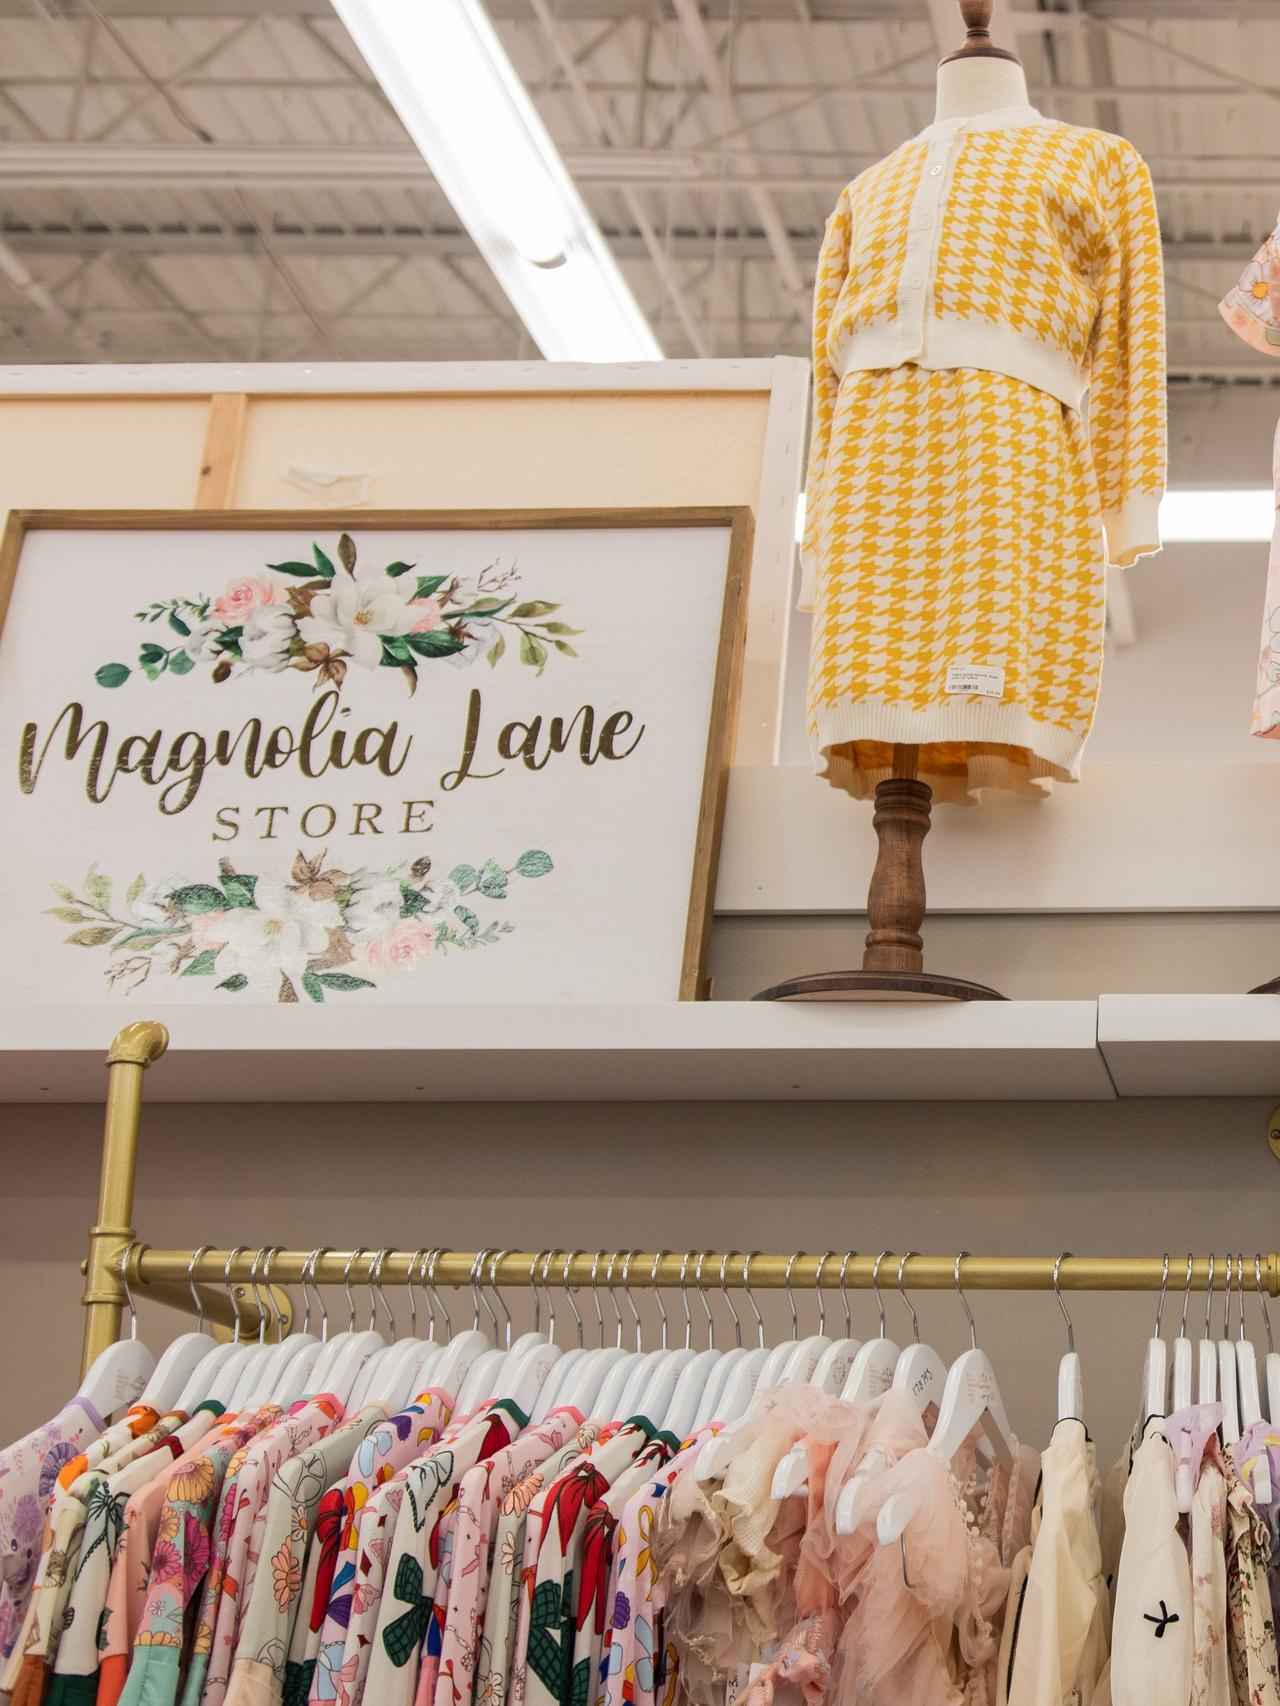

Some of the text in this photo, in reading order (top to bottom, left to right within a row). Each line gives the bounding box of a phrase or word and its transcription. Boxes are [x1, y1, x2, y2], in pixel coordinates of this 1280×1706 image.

[18, 688, 646, 815] Magnolia Lane
[212, 800, 436, 842] STORE
